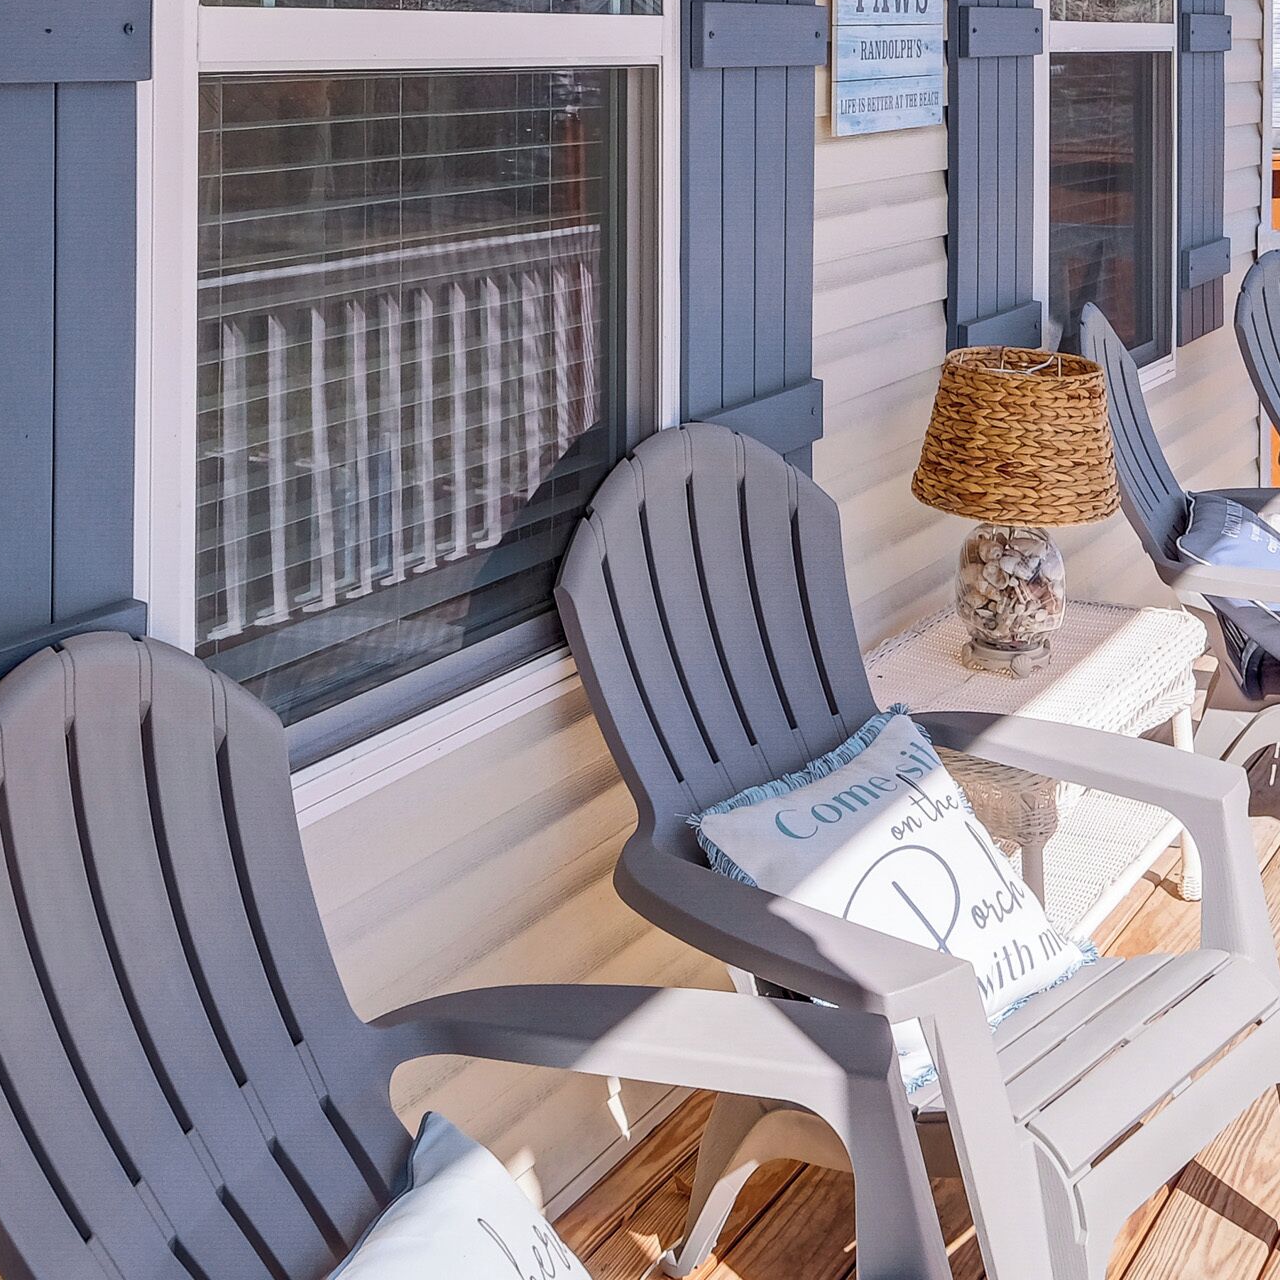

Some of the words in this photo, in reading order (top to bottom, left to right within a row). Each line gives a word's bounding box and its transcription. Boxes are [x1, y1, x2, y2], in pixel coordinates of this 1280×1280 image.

[860, 39, 922, 61] RANDOLPH'S
[840, 98, 857, 115] LIFE
[858, 96, 866, 113] IS
[867, 95, 894, 112] BETTER
[894, 94, 903, 109] AT
[905, 93, 918, 108] THE
[919, 91, 939, 106] BEACH
[775, 776, 897, 839] Come
[895, 741, 943, 779] sit
[896, 773, 959, 822] the
[890, 815, 923, 841] on
[977, 939, 1035, 1000] with
